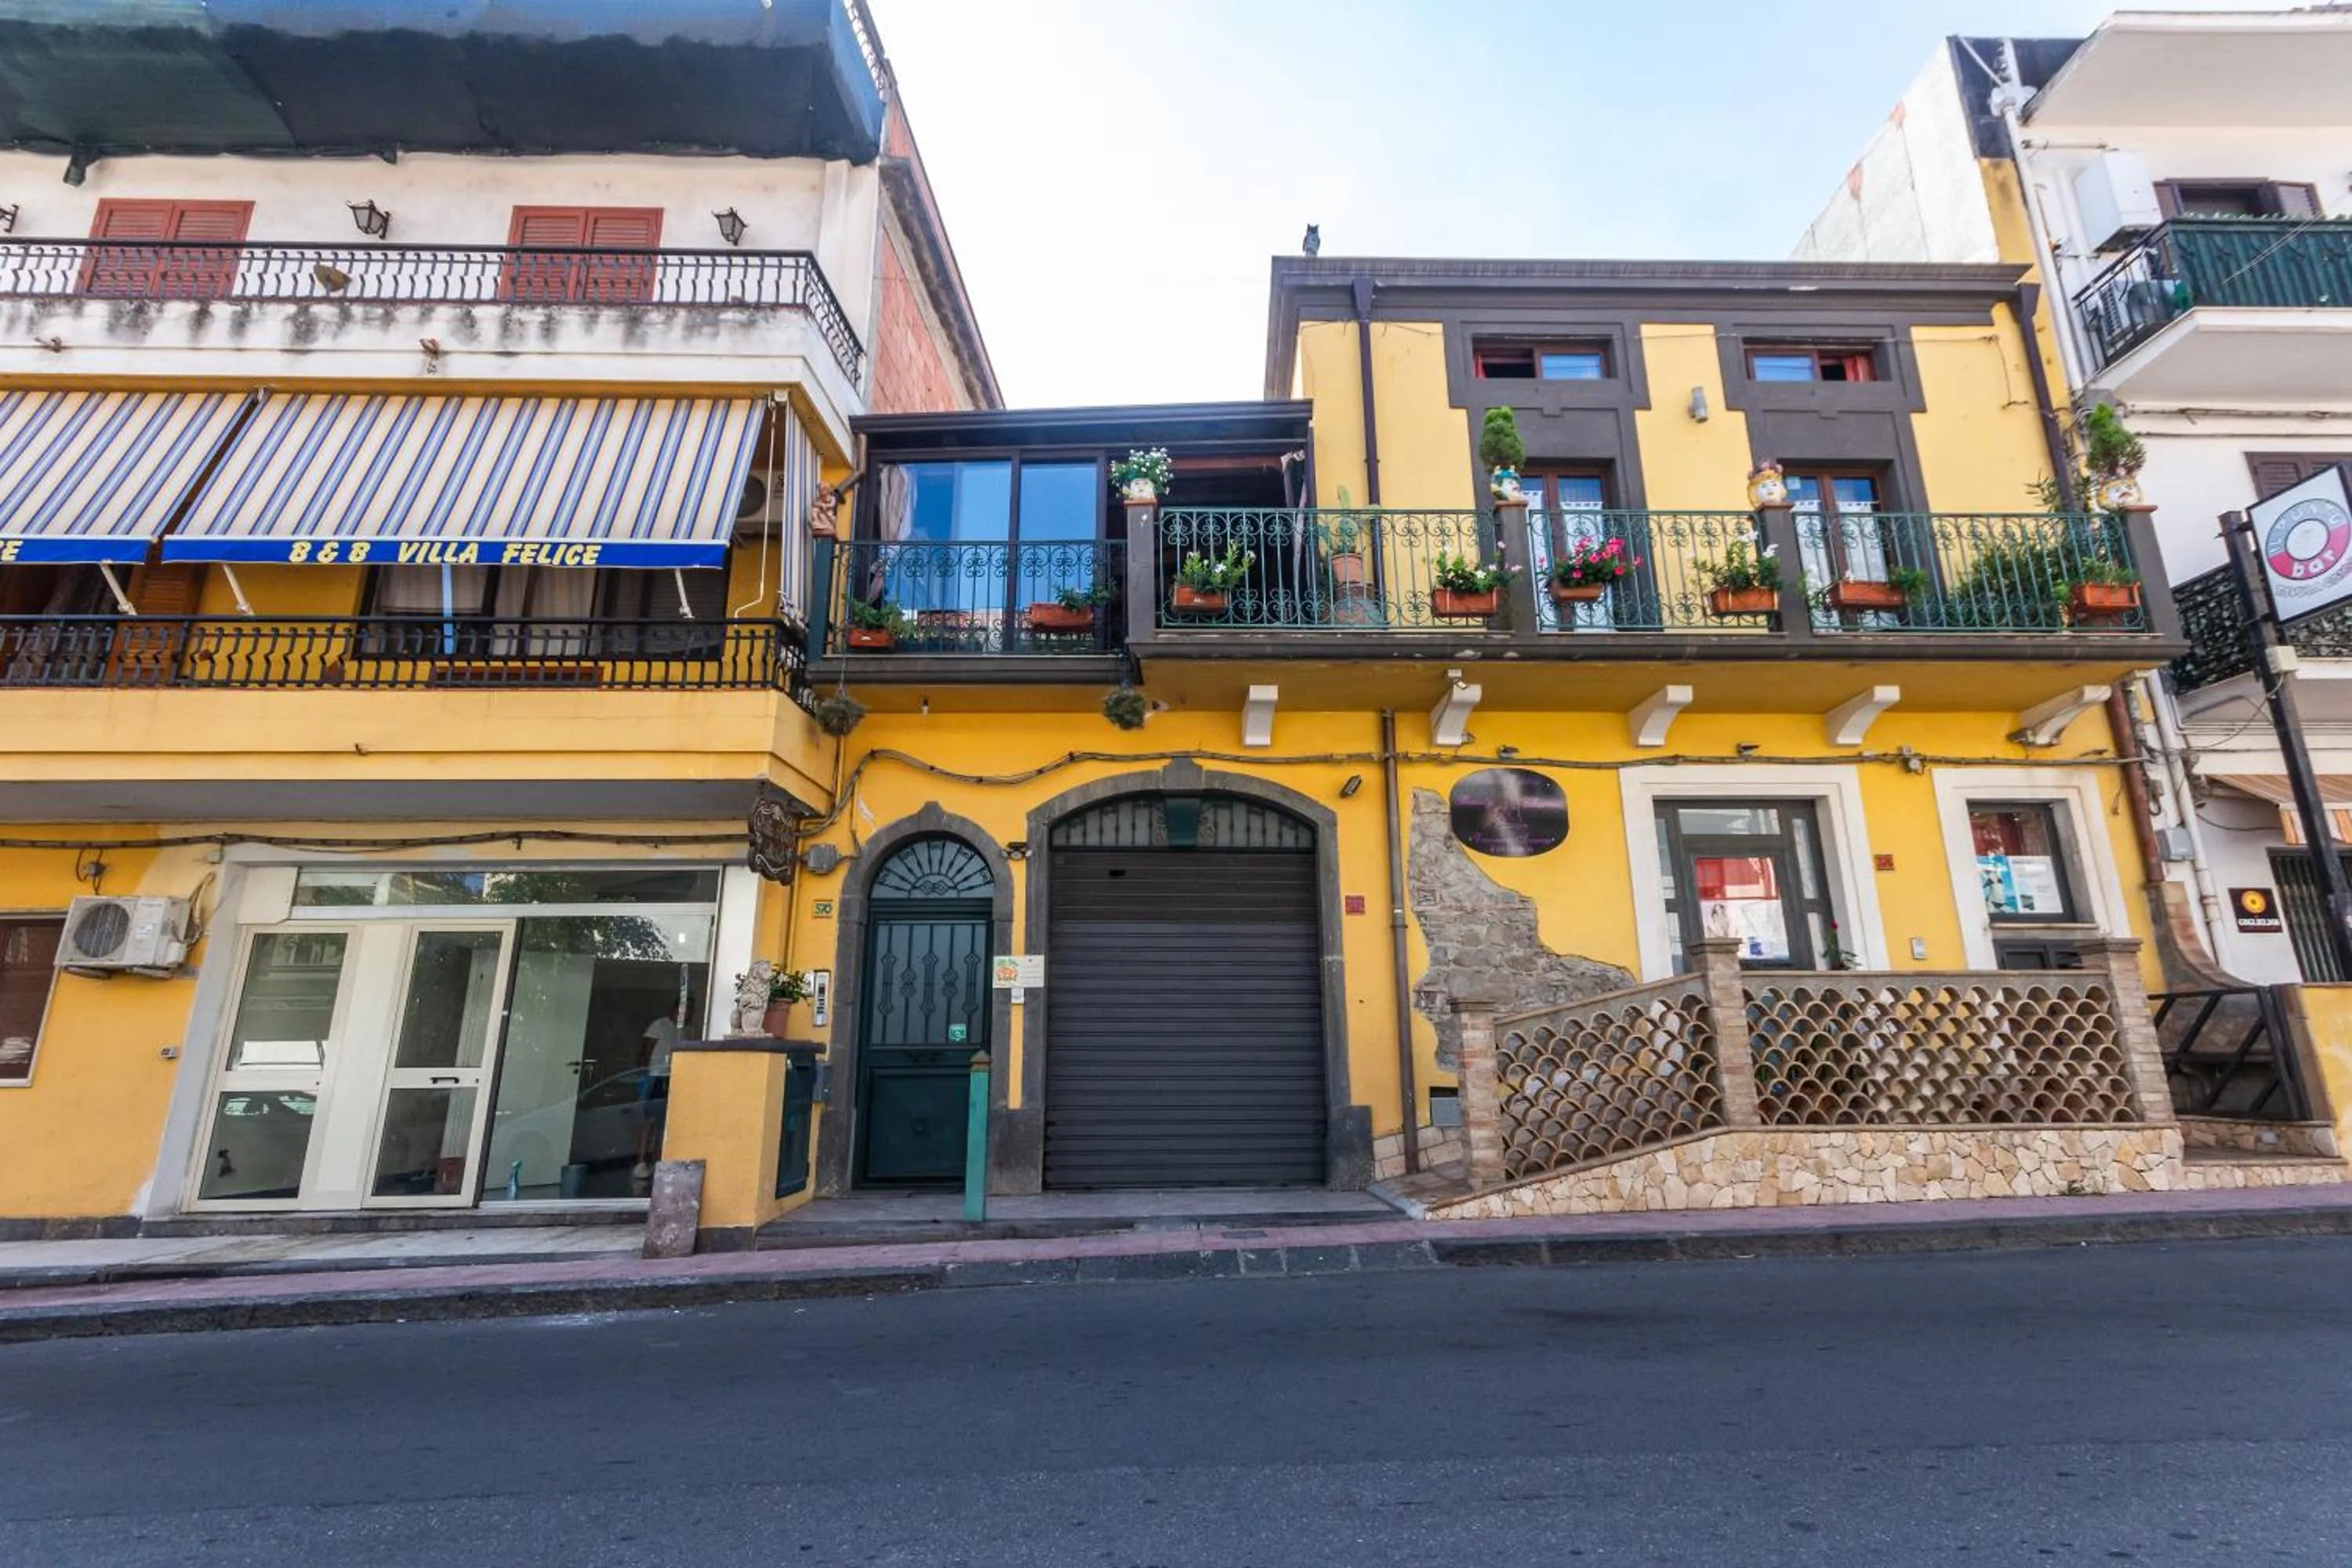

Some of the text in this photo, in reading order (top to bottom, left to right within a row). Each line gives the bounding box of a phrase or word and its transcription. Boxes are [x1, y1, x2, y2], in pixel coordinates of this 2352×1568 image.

[0, 539, 24, 562] E
[317, 541, 339, 563] &
[397, 542, 479, 564] VILLA
[502, 543, 602, 565] FELICE
[2291, 550, 2336, 578] bar
